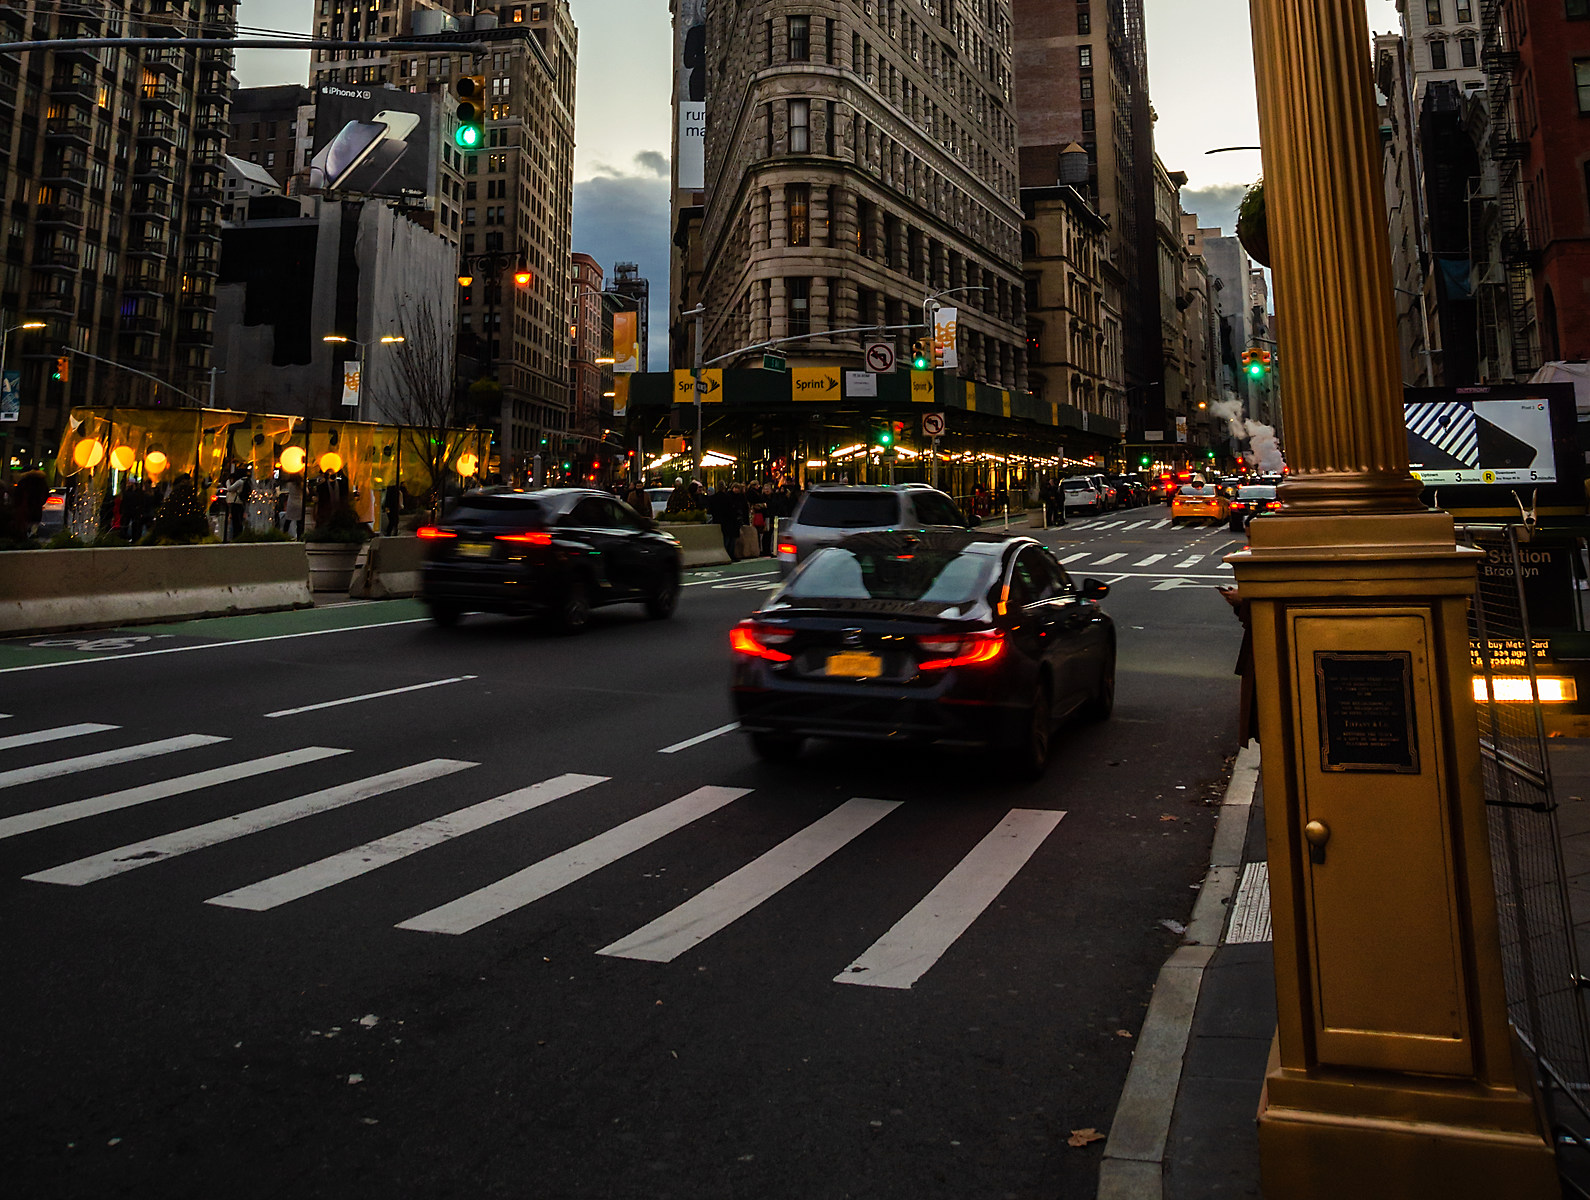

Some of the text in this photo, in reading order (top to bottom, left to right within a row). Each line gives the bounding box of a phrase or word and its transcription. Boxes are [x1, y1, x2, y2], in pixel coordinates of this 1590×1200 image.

[328, 87, 356, 98] iPhone
[796, 379, 824, 391] Sprint
[913, 381, 927, 392] Sprint
[1455, 472, 1462, 482] 3
[1486, 473, 1492, 481] R
[1530, 470, 1538, 481] 5
[1484, 566, 1539, 578] Broolyn
